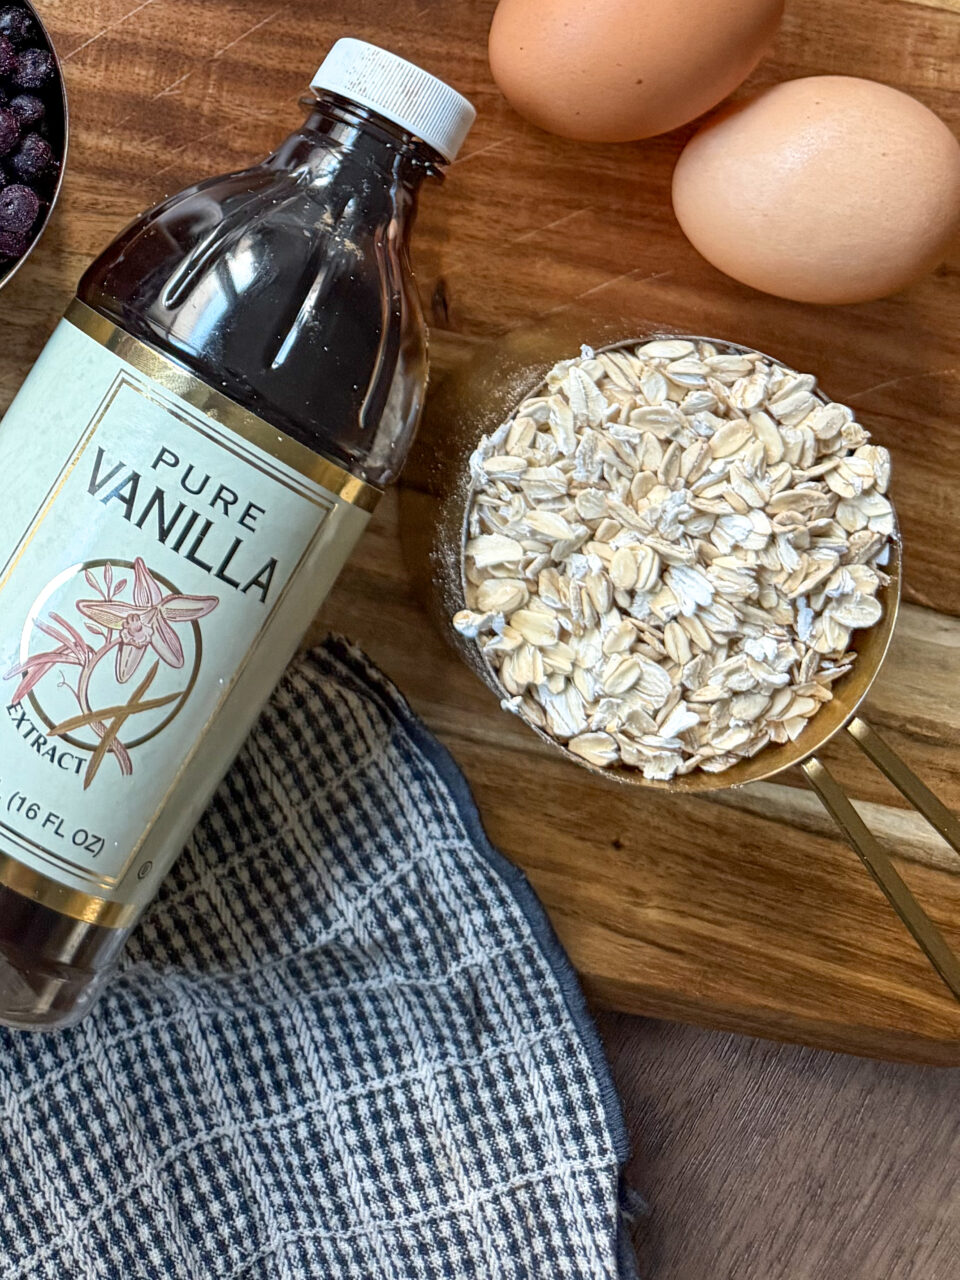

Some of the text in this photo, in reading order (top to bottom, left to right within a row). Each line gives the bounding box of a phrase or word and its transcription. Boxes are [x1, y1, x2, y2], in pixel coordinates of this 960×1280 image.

[85, 445, 290, 606] VANILLA
[150, 445, 267, 533] PURE
[5, 702, 88, 776] EXTRACT
[7, 790, 42, 823] (16
[42, 813, 67, 838] FL
[71, 829, 106, 859] OZ)
